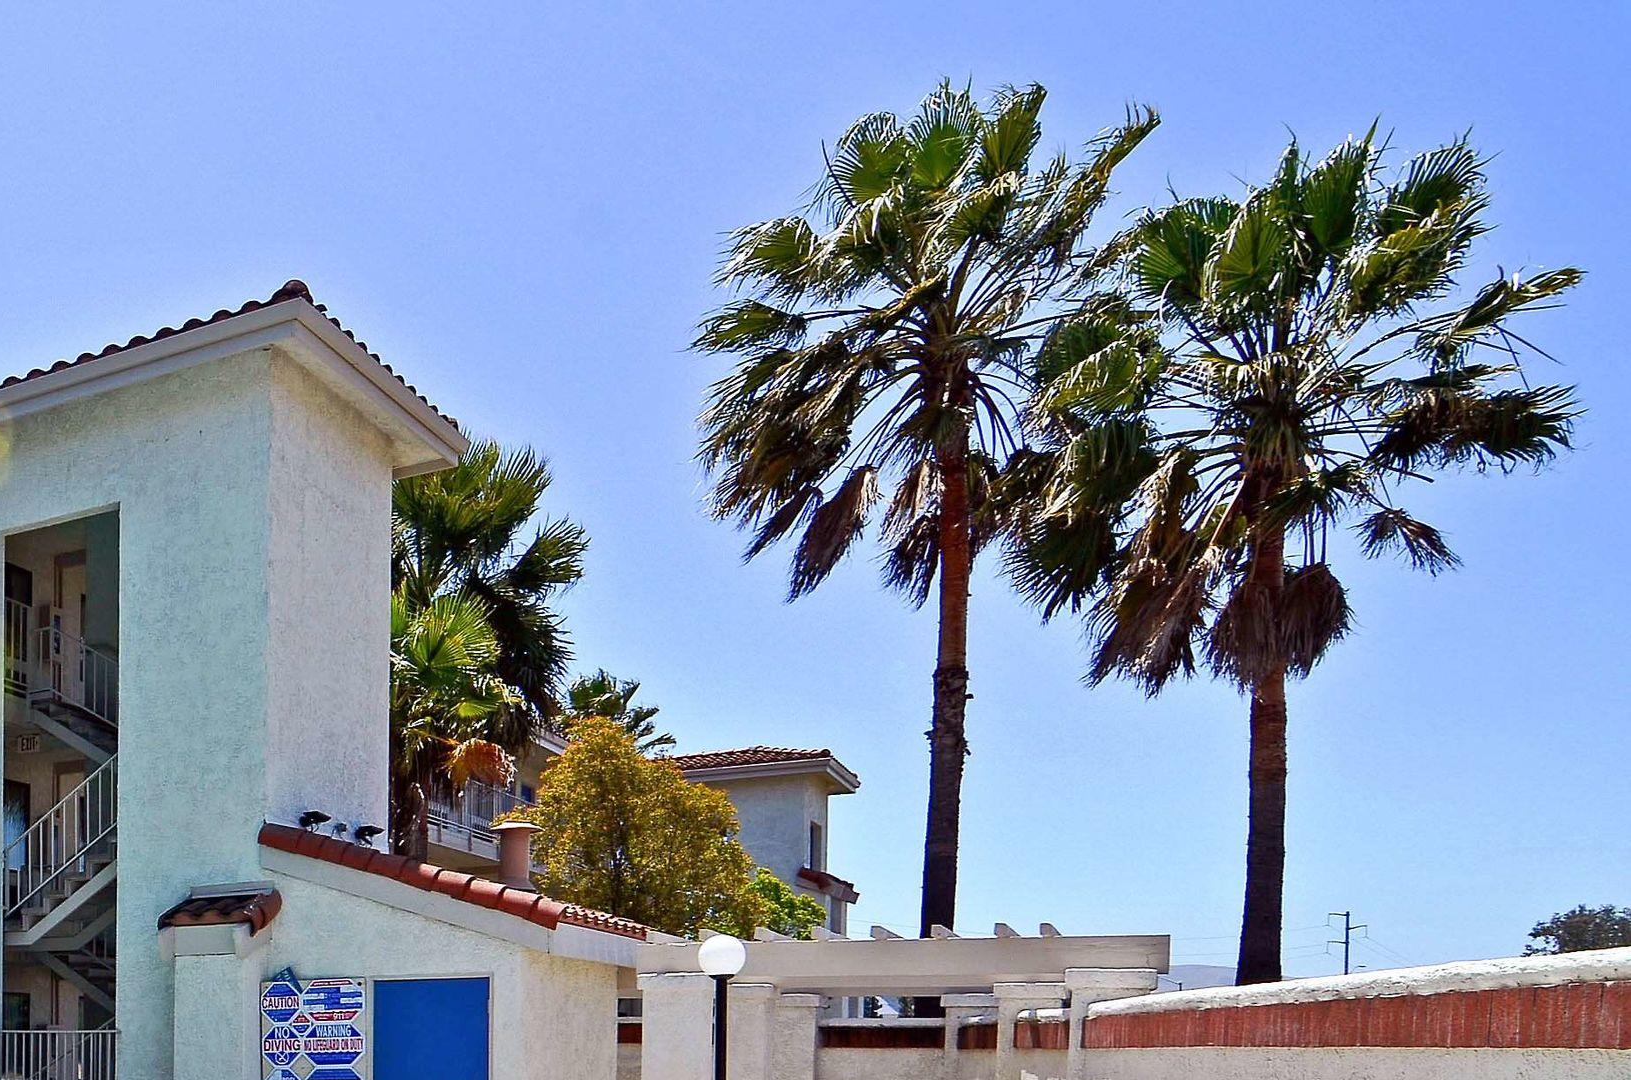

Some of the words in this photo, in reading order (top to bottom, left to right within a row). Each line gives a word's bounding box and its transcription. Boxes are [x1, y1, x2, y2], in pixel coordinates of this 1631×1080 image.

[21, 737, 36, 751] EXIT
[262, 997, 299, 1009] CAUTION
[274, 1027, 290, 1039] NO
[316, 1025, 351, 1037] WARNING
[264, 1039, 301, 1051] DIVING
